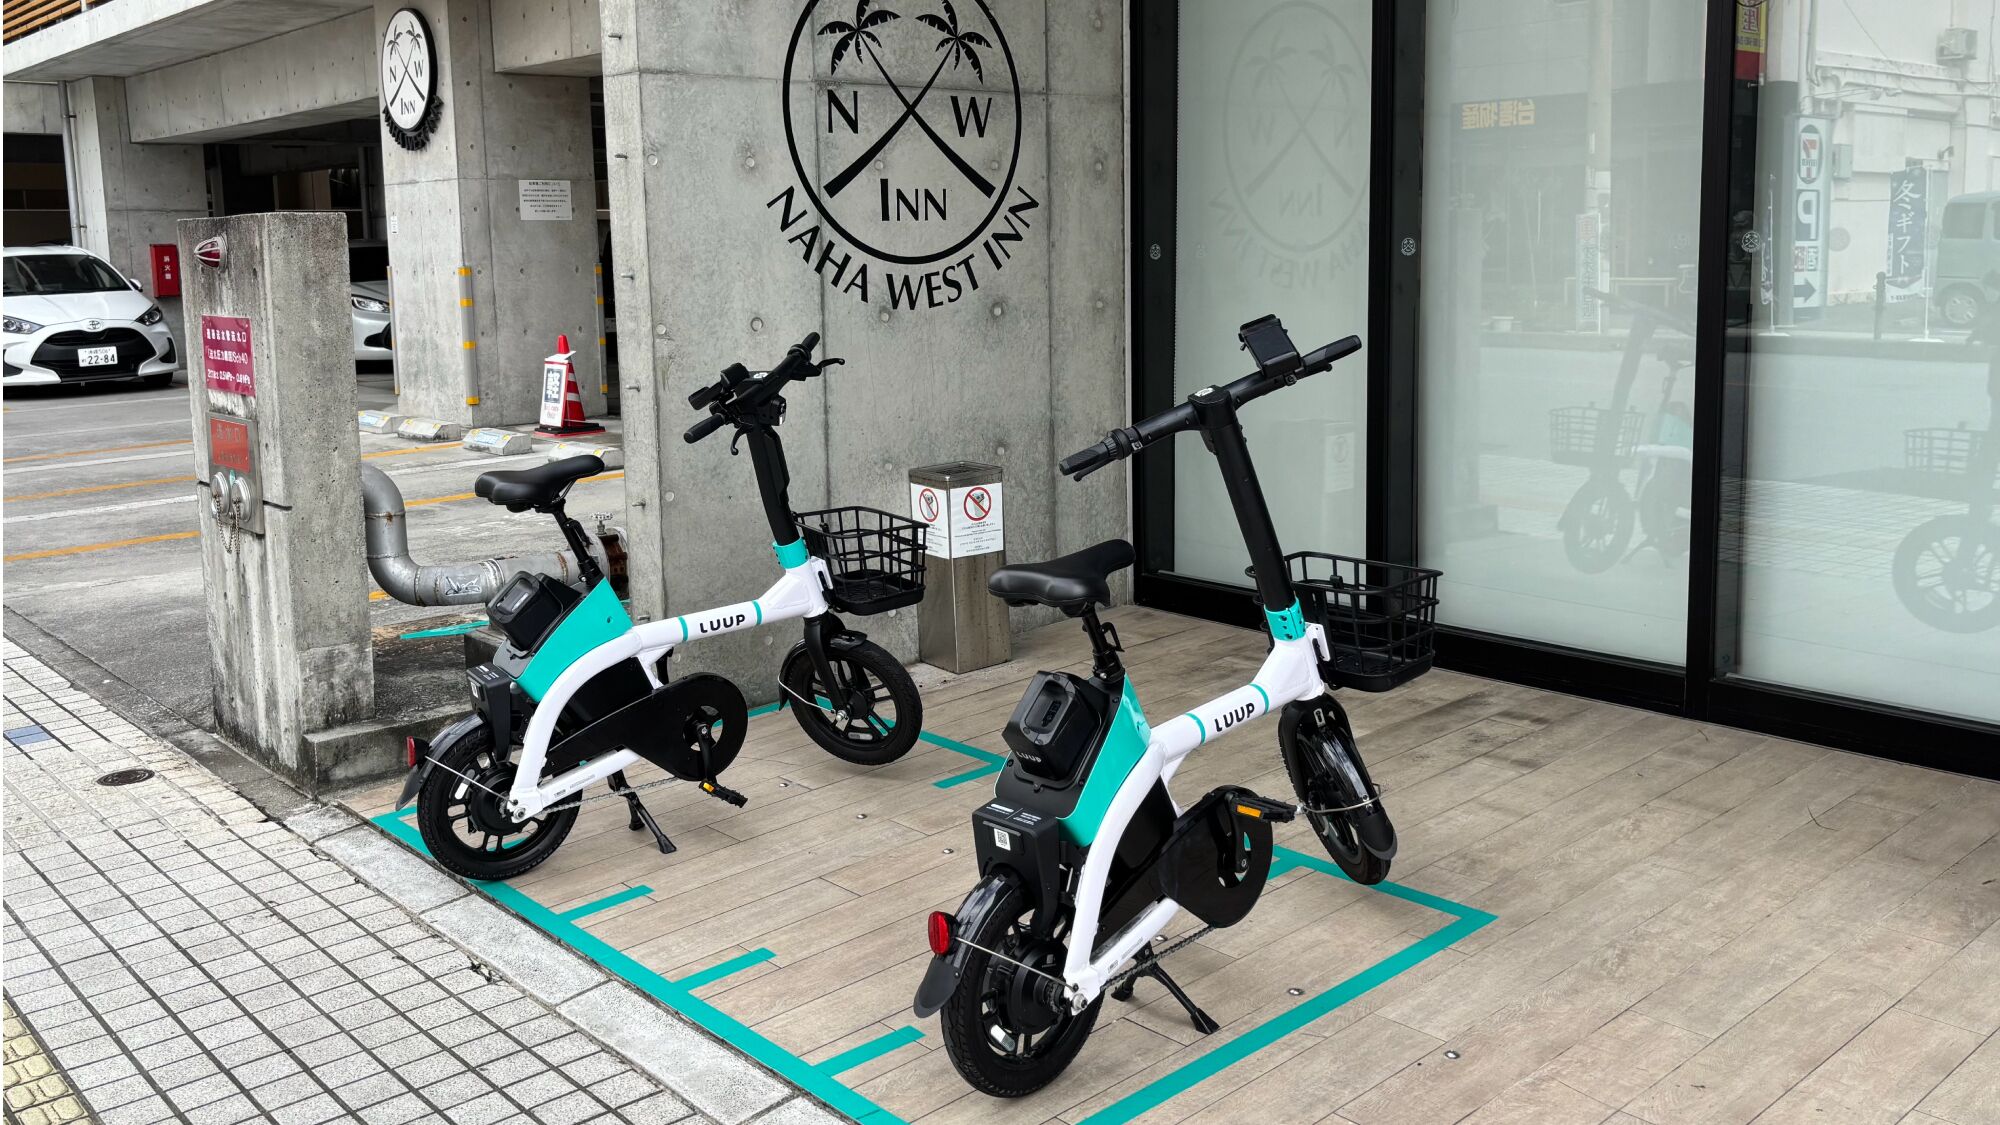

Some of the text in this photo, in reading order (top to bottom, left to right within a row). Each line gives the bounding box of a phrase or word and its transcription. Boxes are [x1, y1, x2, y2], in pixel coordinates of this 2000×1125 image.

[390, 61, 424, 84] N W
[828, 90, 993, 138] N W
[880, 178, 947, 221] INN
[1893, 179, 1922, 275] 冬ギフト
[766, 185, 1040, 311] NAHA WEST INN
[88, 354, 115, 365] 22-84
[699, 614, 746, 634] LUUP
[1214, 702, 1256, 732] LUUP
[1015, 750, 1042, 763] LUUP
